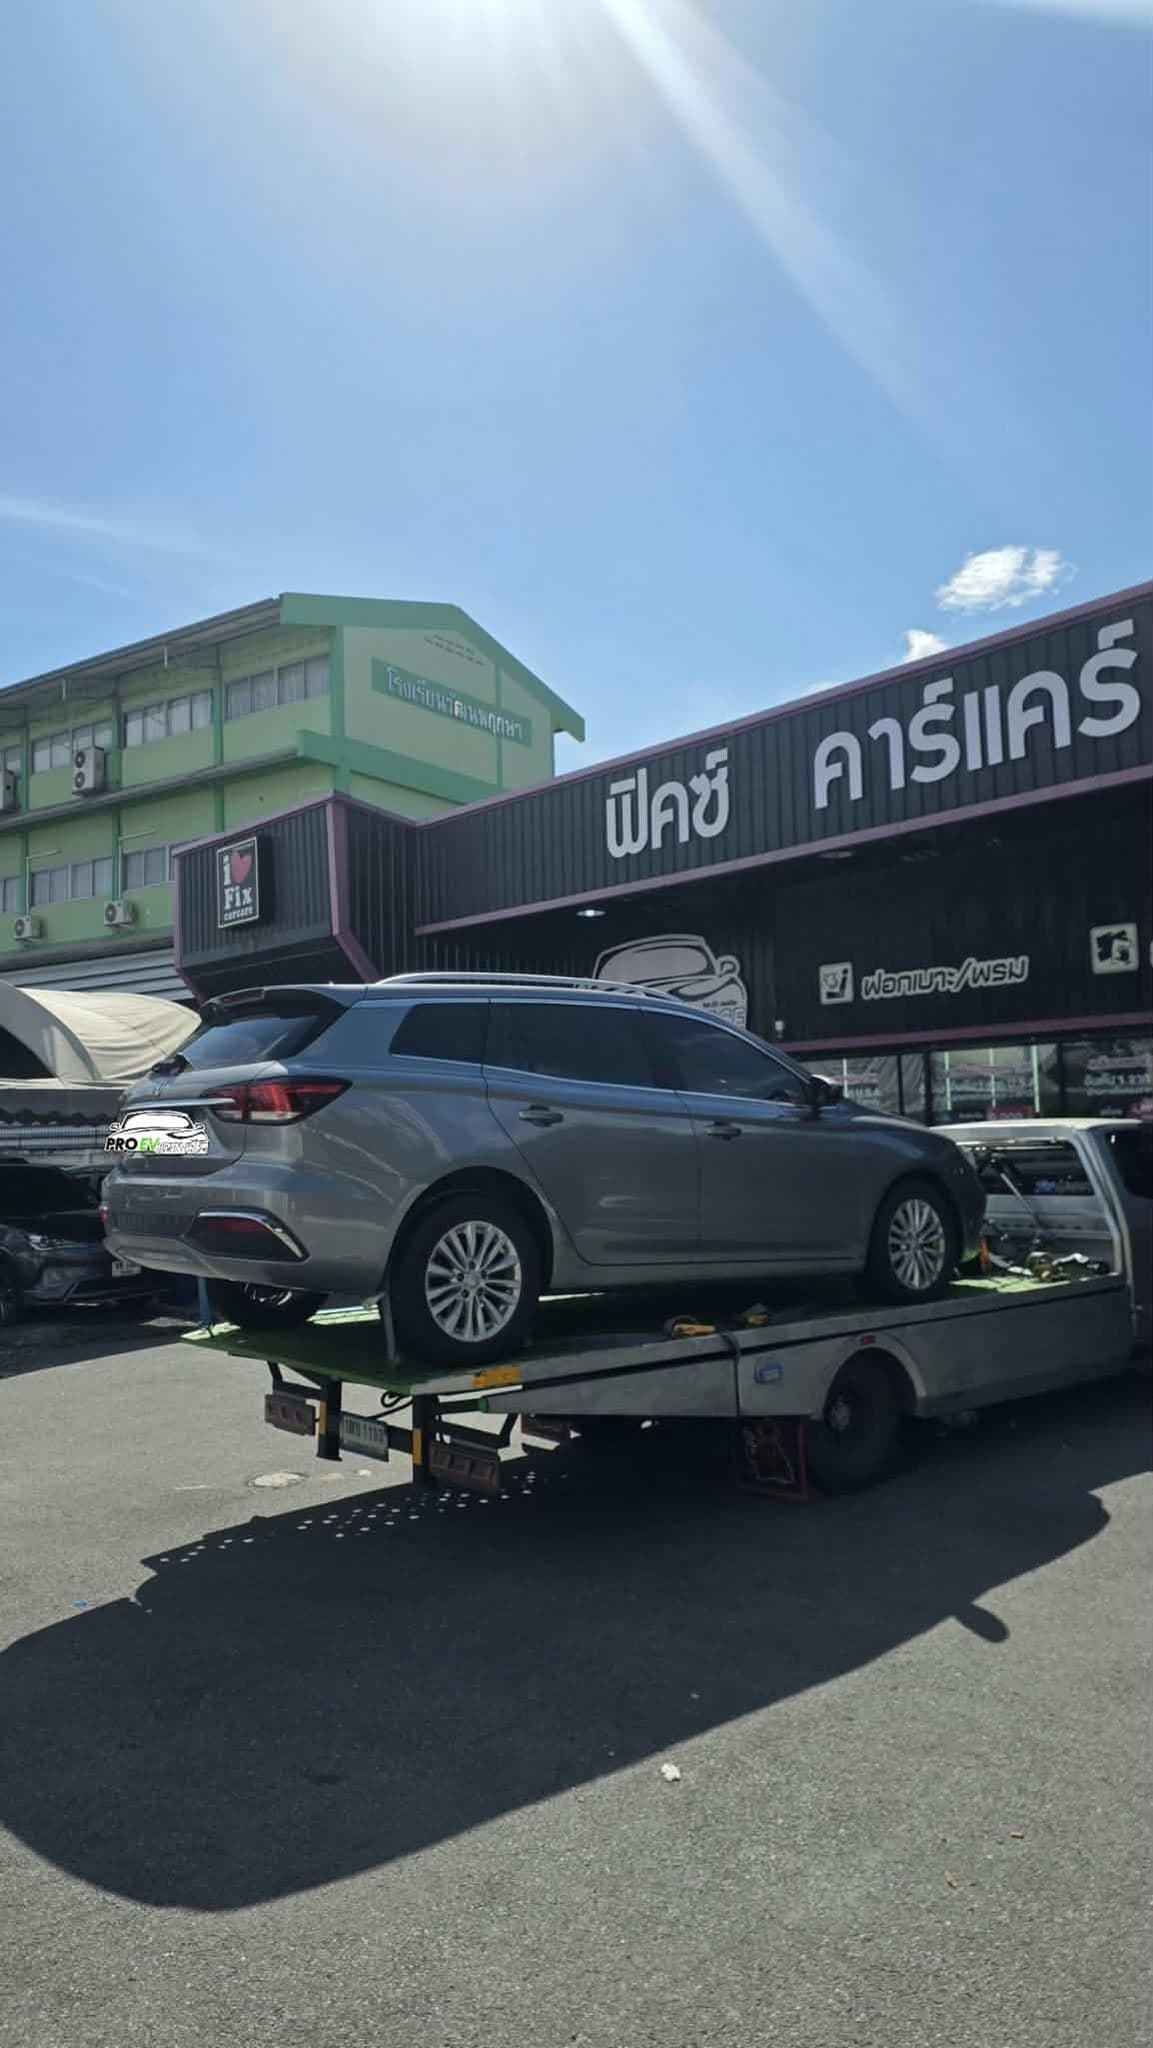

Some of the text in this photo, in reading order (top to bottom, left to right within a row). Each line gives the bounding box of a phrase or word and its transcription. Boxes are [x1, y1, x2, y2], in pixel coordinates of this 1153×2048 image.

[814, 619, 1141, 810] คาร์แคร์
[224, 886, 253, 910] Fix
